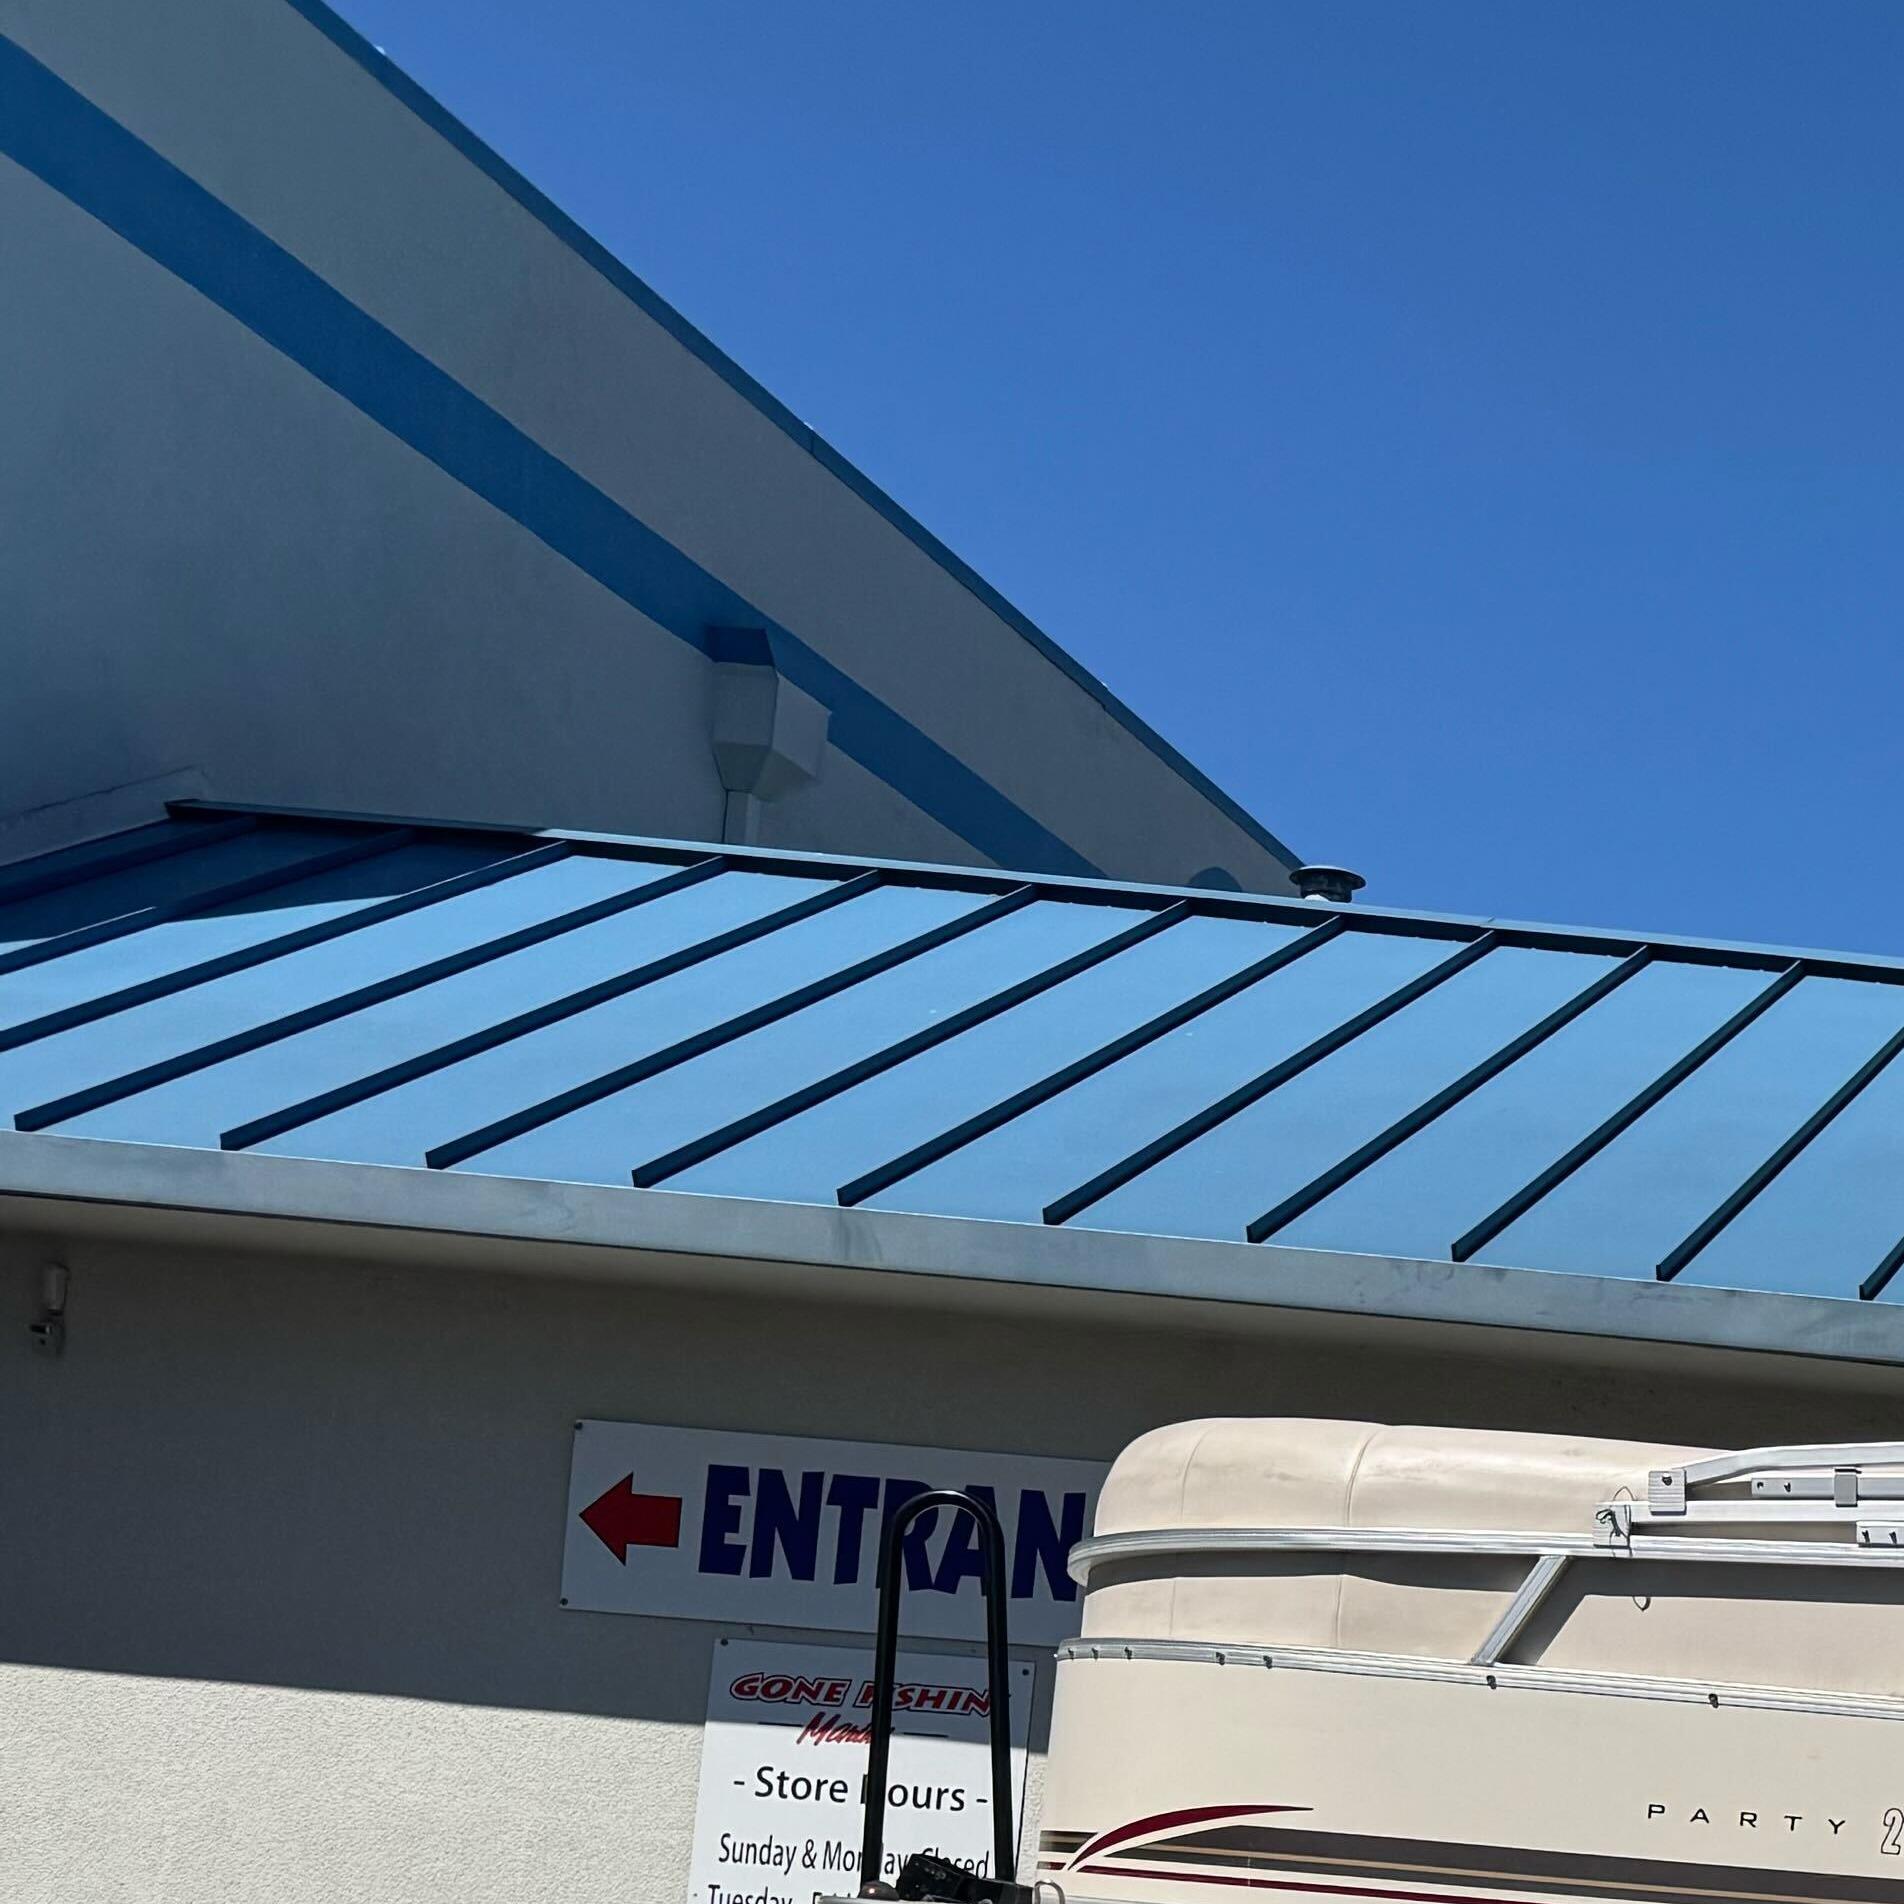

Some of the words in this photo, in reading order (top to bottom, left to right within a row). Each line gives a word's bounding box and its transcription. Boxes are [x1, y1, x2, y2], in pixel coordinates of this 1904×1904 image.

[697, 1463, 1087, 1602] ENTRAN
[730, 1672, 852, 1707] GONE
[854, 1680, 992, 1717] FSHIN
[754, 1765, 849, 1804] Store
[1647, 1803, 1846, 1836] PARTY
[718, 1832, 798, 1876] Sunday
[801, 1838, 816, 1870] &
[822, 1840, 908, 1875] Moay
